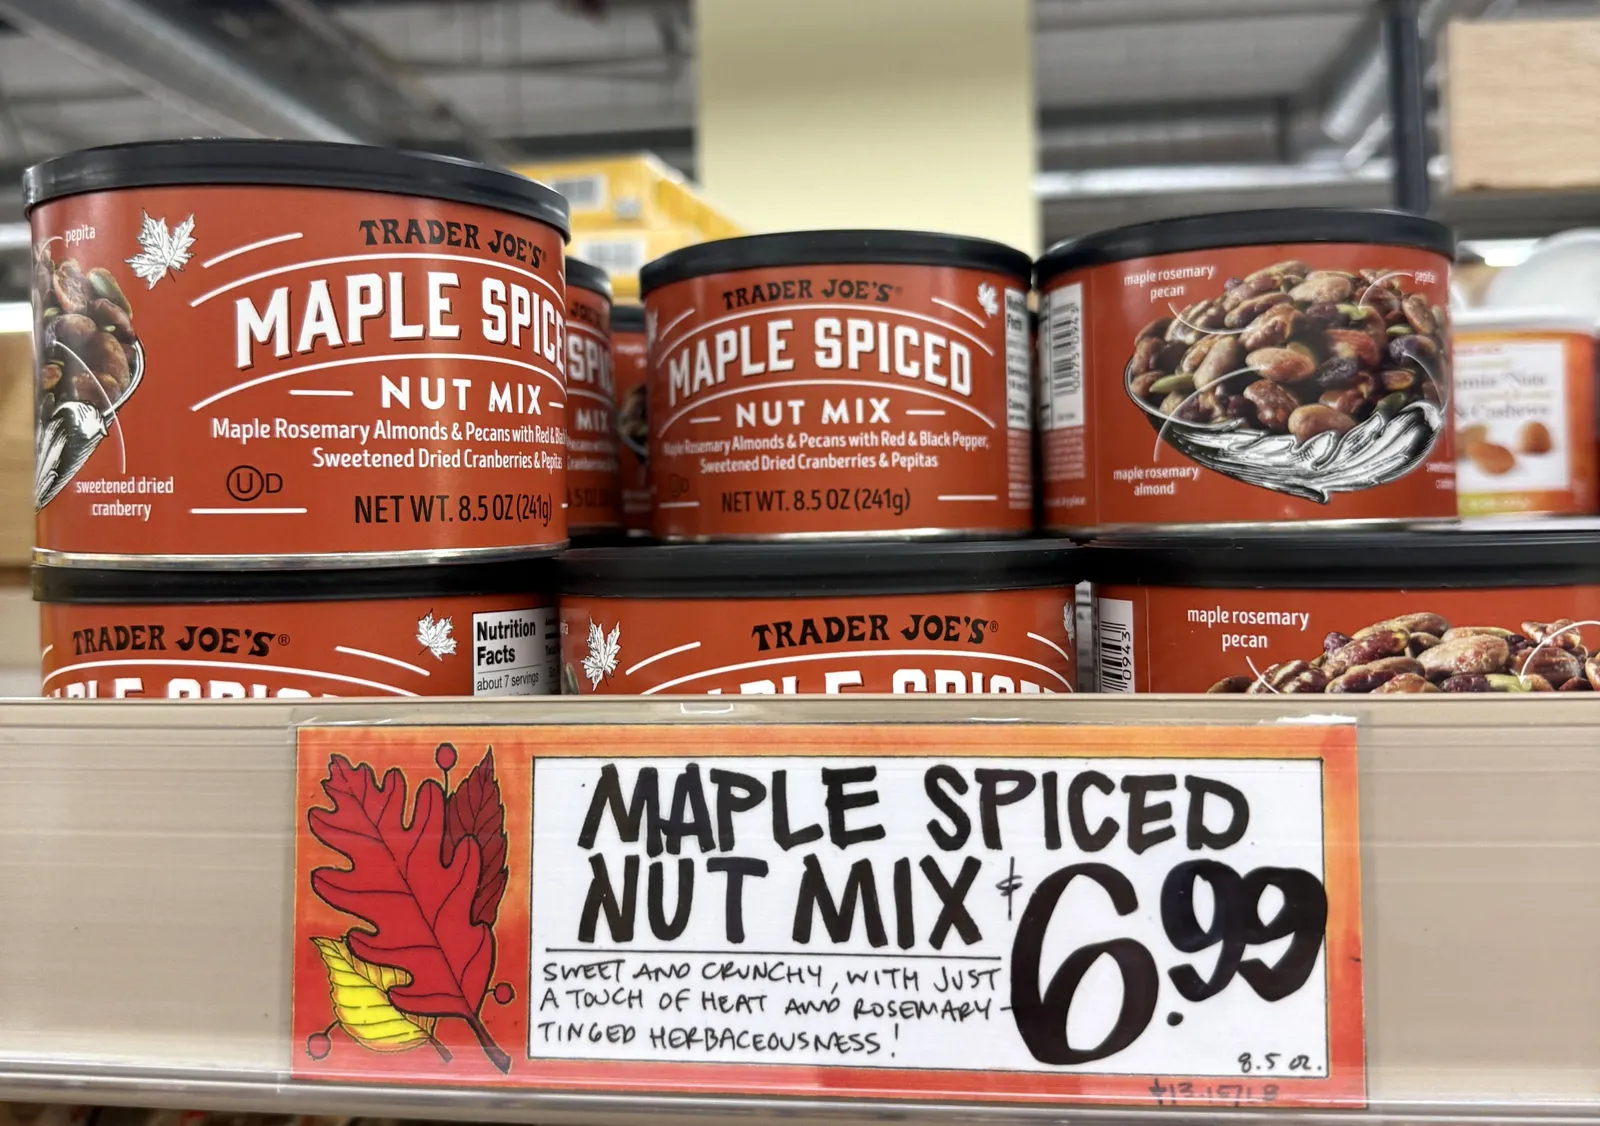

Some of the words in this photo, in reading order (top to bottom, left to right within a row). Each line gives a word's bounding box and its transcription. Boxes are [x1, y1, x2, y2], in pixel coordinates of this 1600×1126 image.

[65, 224, 96, 248] pepita
[359, 218, 481, 250] TRADER
[1124, 269, 1156, 288] maple
[1158, 265, 1214, 281] rosemary
[722, 279, 813, 311] TRADER
[1150, 285, 1185, 303] pecan
[236, 271, 462, 371] MAPLE
[668, 318, 795, 408] MAPLE
[814, 317, 973, 398] SPICED
[381, 375, 472, 411] NUT
[488, 380, 542, 415] MIX
[736, 399, 806, 429] NUT
[820, 397, 891, 424] MIX
[212, 417, 271, 445] Maple
[275, 417, 370, 446] Rosemary
[373, 419, 449, 441] Almonds
[451, 421, 463, 441] &
[466, 421, 511, 442] Pecans
[512, 423, 535, 444] with
[536, 425, 550, 444] Red
[550, 427, 556, 444] &
[684, 439, 732, 456] Rosemary
[731, 434, 785, 451] Almonds
[786, 433, 797, 449] &
[799, 432, 847, 448] Pecans
[848, 430, 879, 447] with
[881, 430, 906, 447] Red
[907, 430, 918, 447] &
[919, 430, 950, 447] Black
[952, 431, 989, 451] Pepper,
[312, 446, 414, 468] Sweetened
[418, 447, 461, 468] Dried
[464, 448, 533, 469] Cranberries
[534, 451, 541, 469] &
[700, 455, 760, 474] Sweetened
[761, 454, 796, 471] Dried
[797, 452, 876, 470] Cranberries
[878, 452, 890, 468] &
[891, 451, 939, 472] Pepitas
[76, 477, 135, 495] sweetened
[138, 476, 174, 494] dried
[1113, 465, 1143, 484] maple
[1145, 466, 1199, 482] rosemary
[721, 491, 751, 513] NET
[756, 489, 789, 512] WT.
[793, 489, 822, 511] 8.5
[826, 488, 851, 510] OZ
[854, 487, 911, 516] (241g)
[1133, 481, 1175, 496] almond
[92, 499, 152, 522] cranberry
[355, 495, 405, 523] NET
[409, 495, 453, 523] WT.
[458, 494, 489, 522] 8.5
[492, 493, 514, 521] OZ
[516, 492, 552, 527] (241g)
[476, 618, 536, 642] Nutrition
[1187, 605, 1230, 629] maple
[1232, 610, 1310, 632] rosemary
[73, 624, 166, 656] TRADER
[751, 614, 890, 651] TRADER
[1221, 633, 1268, 652] pecan
[477, 645, 516, 666] Facts
[477, 675, 503, 692] about
[504, 674, 510, 689] 7
[511, 671, 540, 687] servings
[577, 762, 886, 858] MAPLE
[924, 764, 1250, 855] SPICED
[577, 852, 769, 944] NUT
[792, 852, 983, 950] MIX
[543, 959, 626, 983] SWEET
[632, 962, 691, 982] AND
[846, 966, 920, 992] WITH
[933, 965, 1002, 993] JUST
[540, 987, 560, 1012] A
[566, 986, 643, 1009] TOUCH
[659, 988, 691, 1012] OF
[701, 990, 768, 1015] HEAT
[784, 997, 841, 1017] AND
[537, 1021, 636, 1044] TINGED
[1238, 1052, 1281, 1073] 8.5
